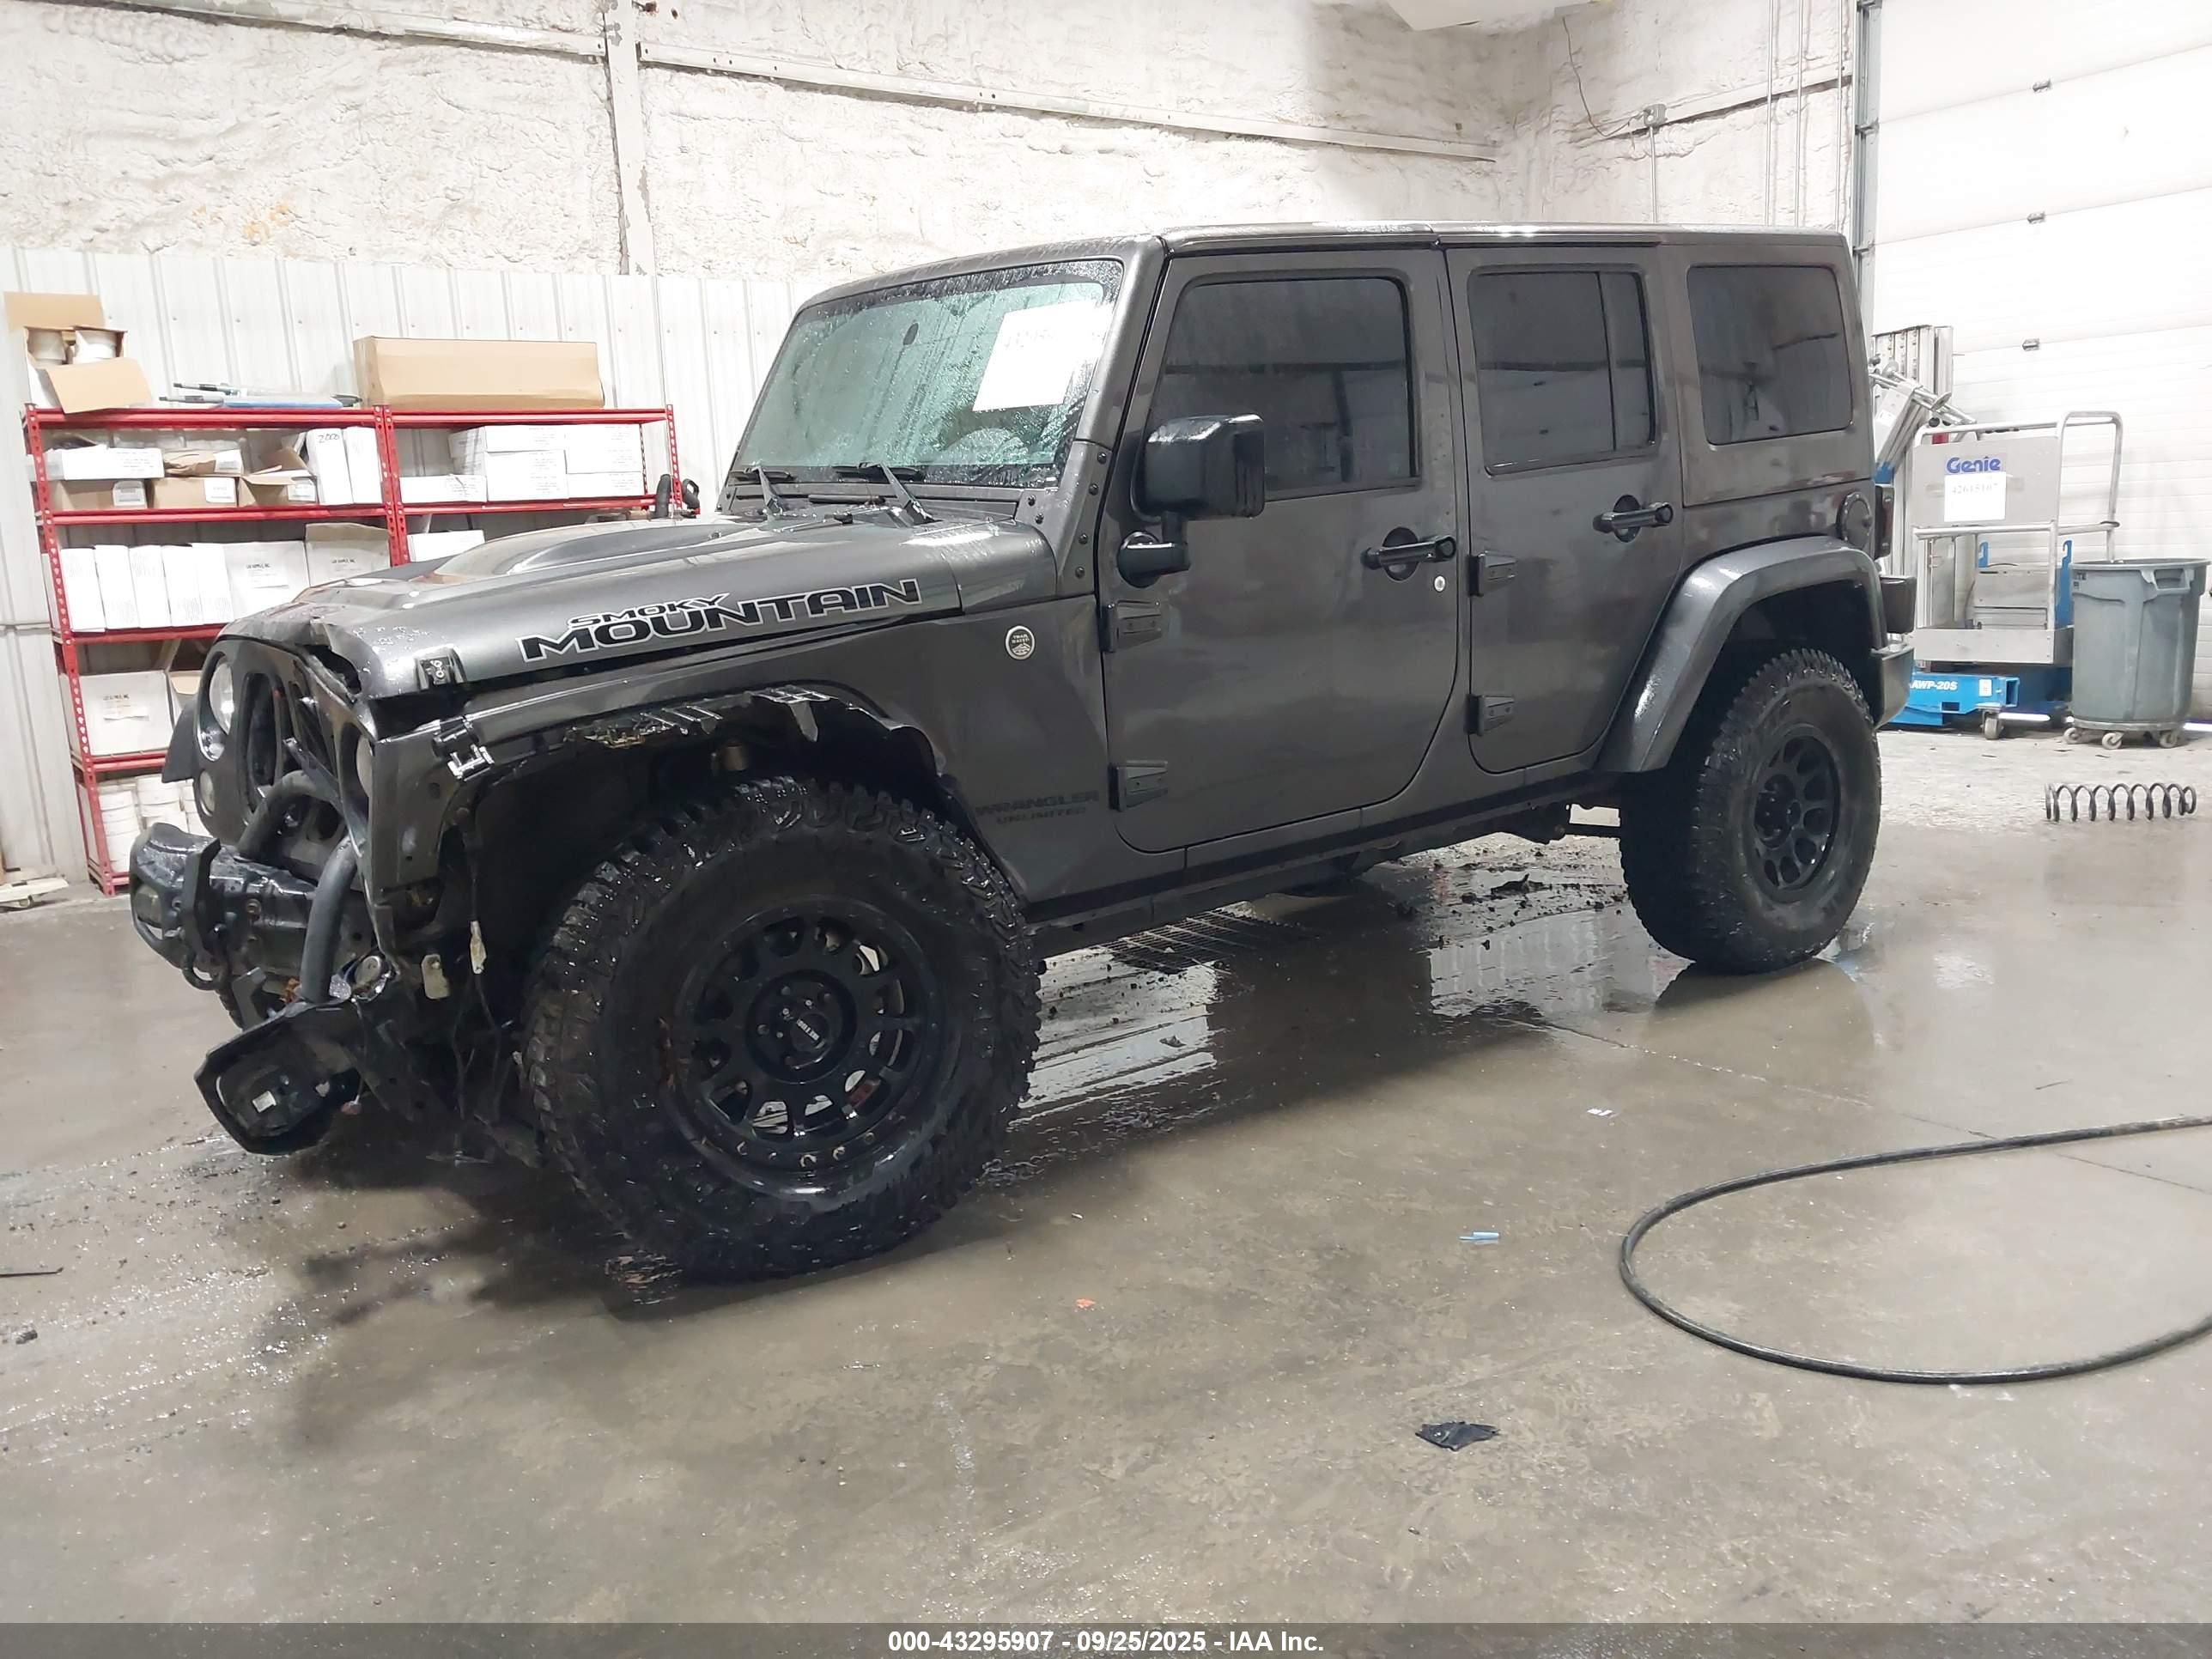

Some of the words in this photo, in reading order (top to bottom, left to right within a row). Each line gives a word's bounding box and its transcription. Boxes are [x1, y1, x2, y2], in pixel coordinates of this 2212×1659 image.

[1947, 456, 2002, 474] Genie
[517, 577, 922, 663] MOUNTAIN
[567, 592, 731, 629] SMOKY
[1910, 679, 1959, 690] AWP-20S
[975, 790, 1100, 816] WRANGLER
